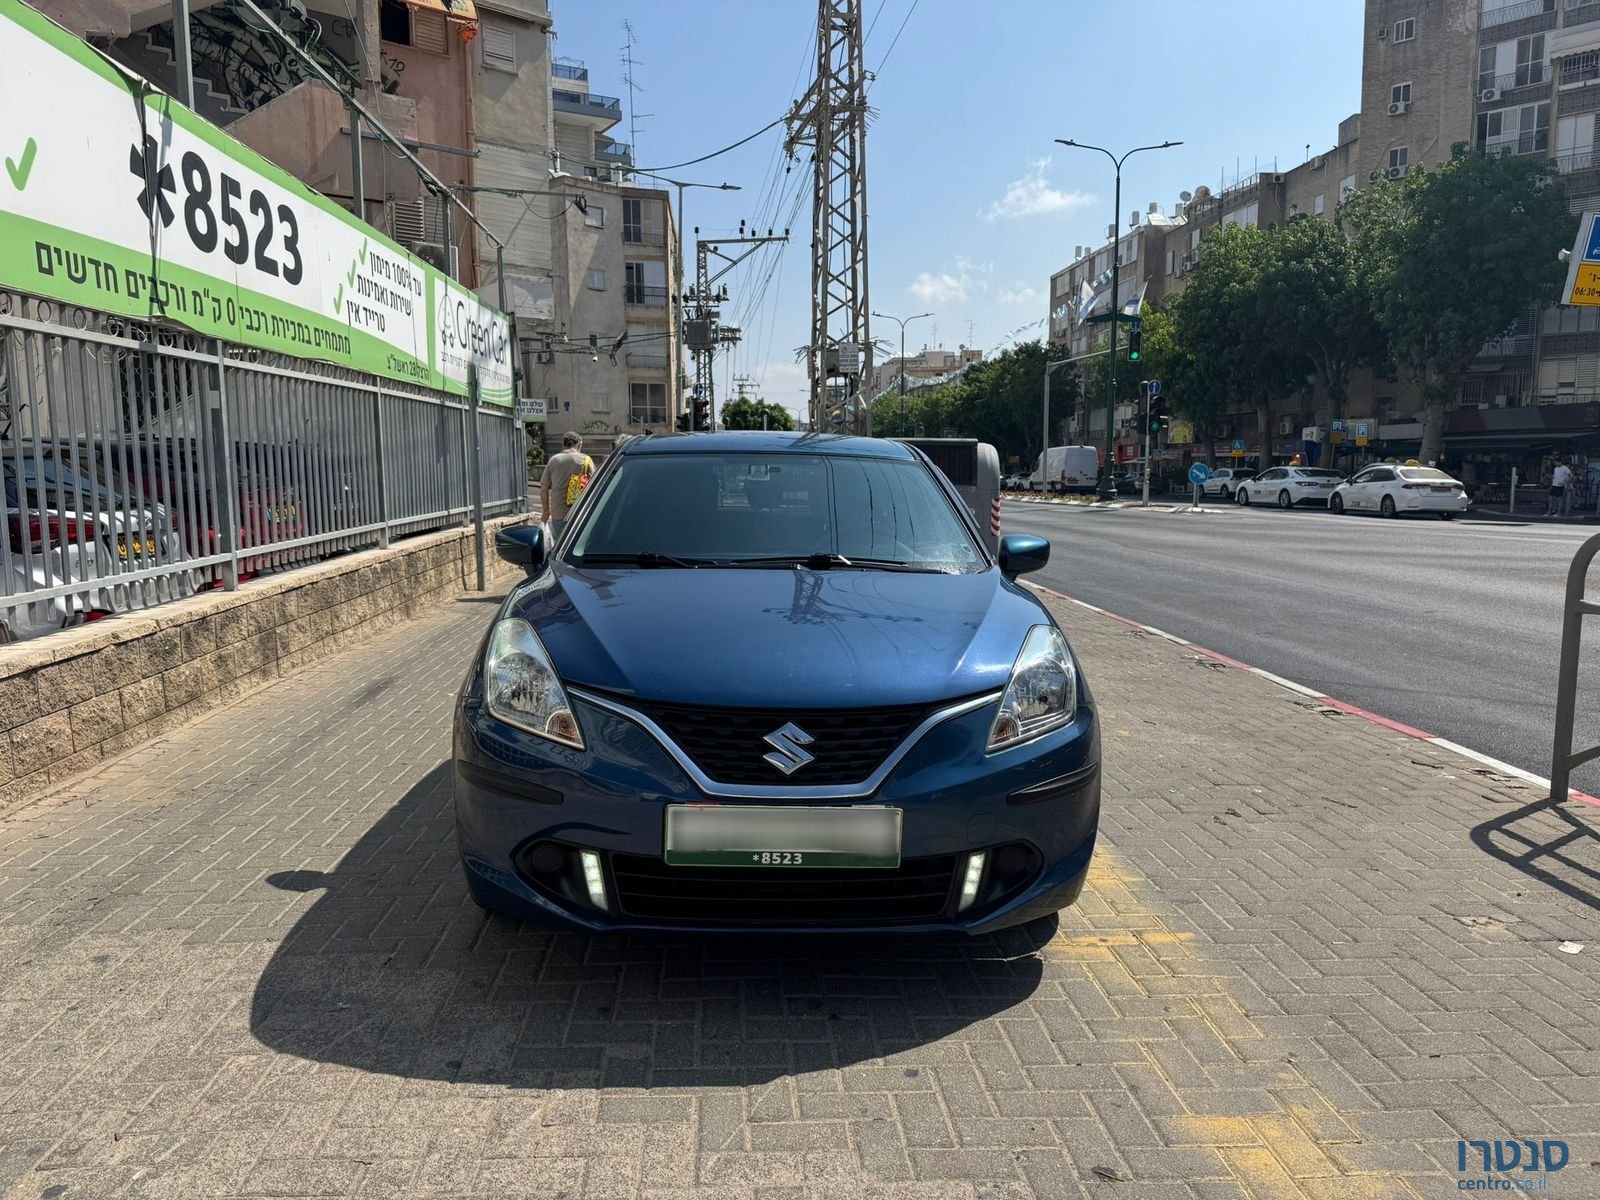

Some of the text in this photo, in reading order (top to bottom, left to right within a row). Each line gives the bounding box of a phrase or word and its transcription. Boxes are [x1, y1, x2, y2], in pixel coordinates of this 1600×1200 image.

[35, 240, 119, 294] חדשים
[369, 251, 422, 298] עד 100% מימון
[125, 269, 187, 313] ורכבים
[357, 274, 412, 317] שירות ואמינות
[239, 305, 269, 335] רכבי
[271, 314, 312, 345] במכירת
[346, 299, 386, 334] טרייד אין
[314, 327, 352, 355] מתמחים
